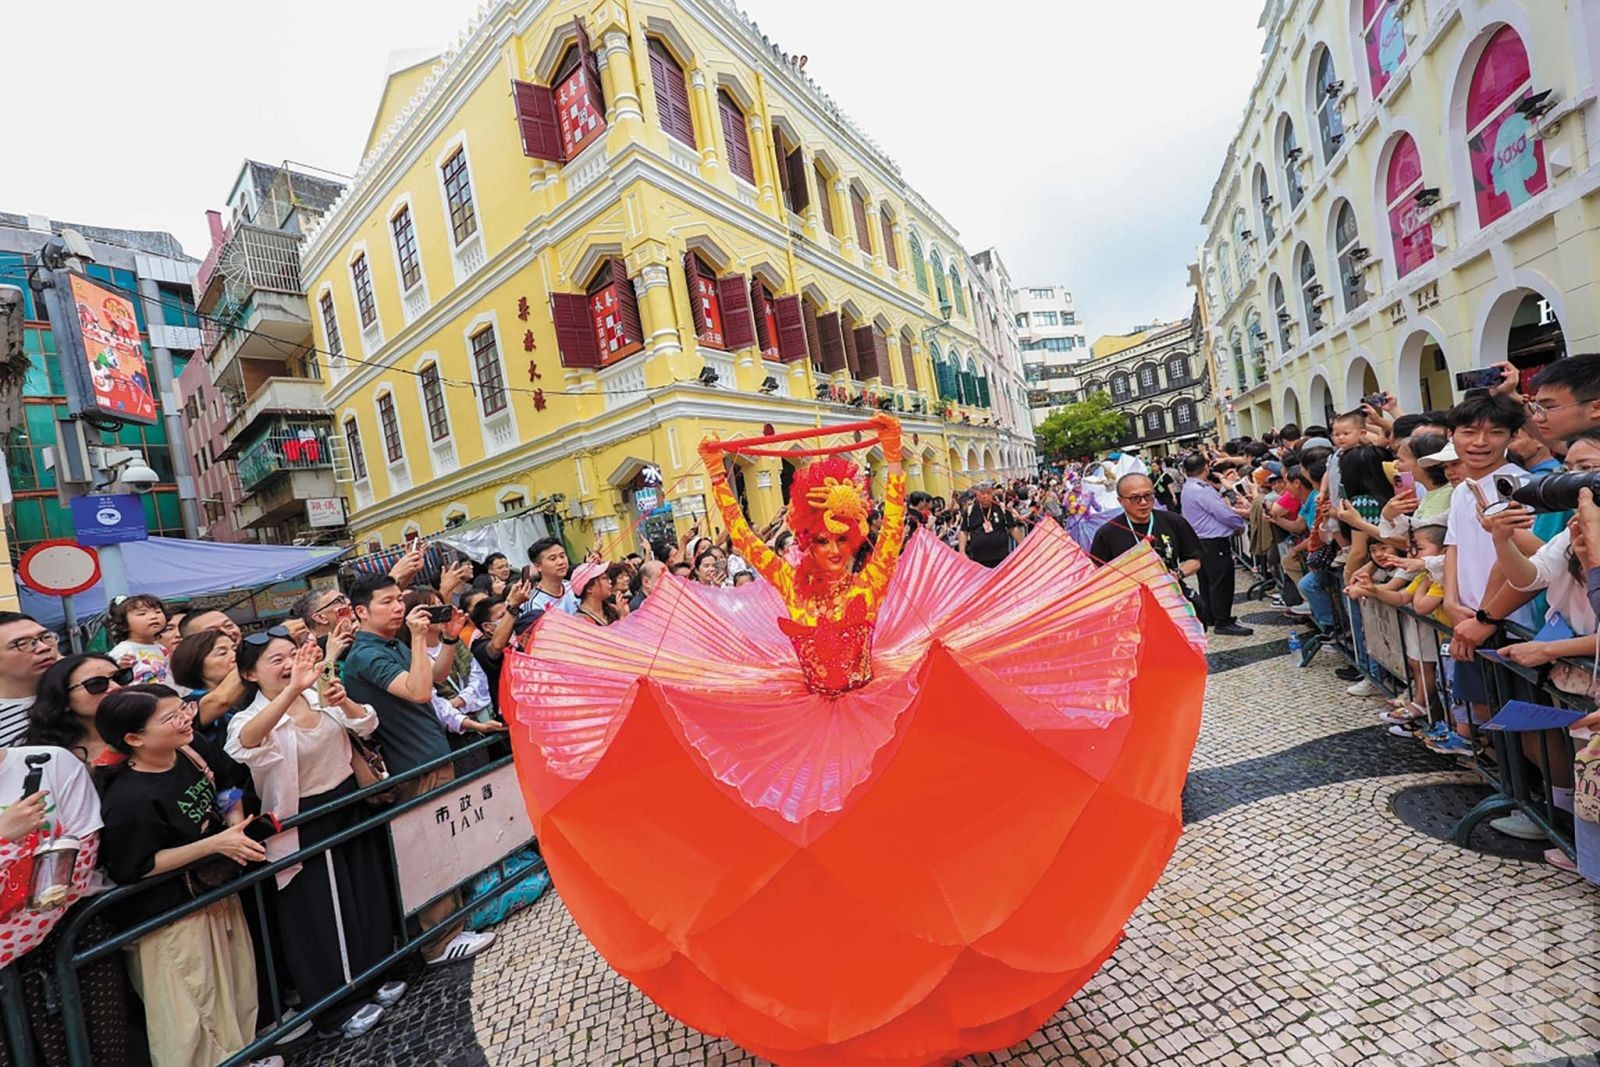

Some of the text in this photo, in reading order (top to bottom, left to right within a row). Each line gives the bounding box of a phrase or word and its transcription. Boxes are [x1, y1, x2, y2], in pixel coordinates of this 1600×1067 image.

[176, 799, 194, 814] A
[435, 783, 493, 825] 市政署
[450, 806, 485, 837] IAM
